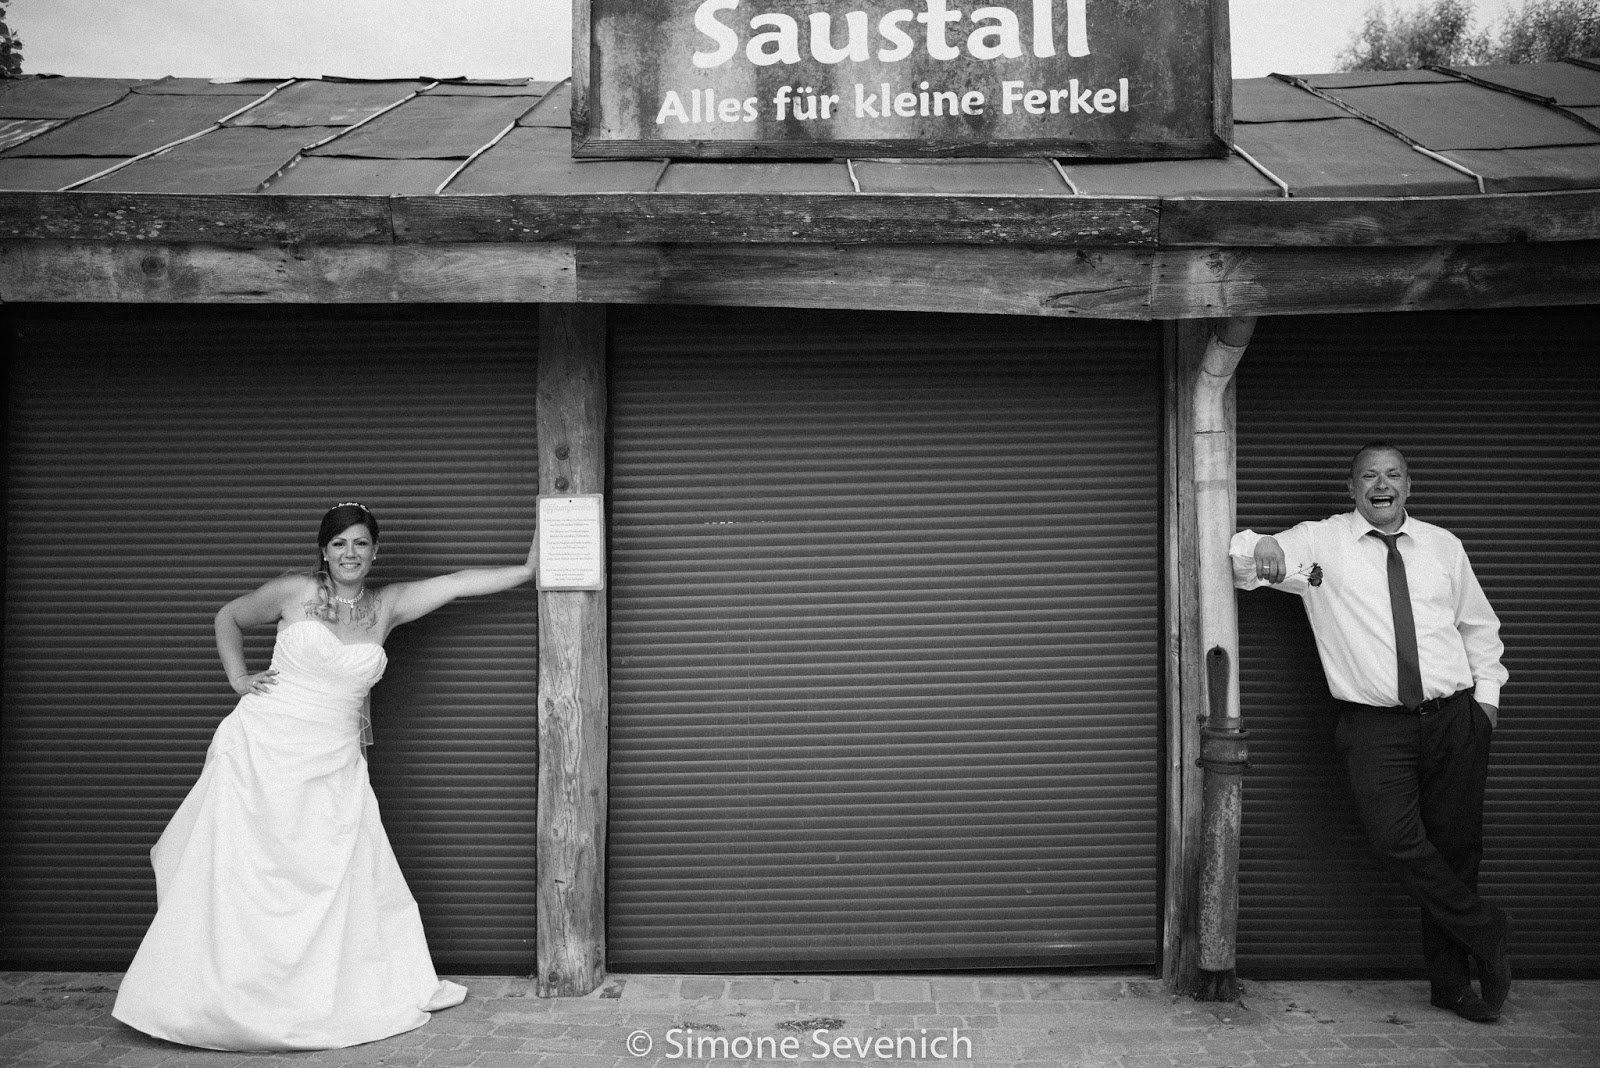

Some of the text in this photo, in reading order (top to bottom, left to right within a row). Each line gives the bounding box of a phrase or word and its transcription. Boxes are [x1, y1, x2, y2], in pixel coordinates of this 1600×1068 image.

[692, 0, 1091, 69] Saustall
[655, 78, 1130, 125] Alles für kleine Ferkel
